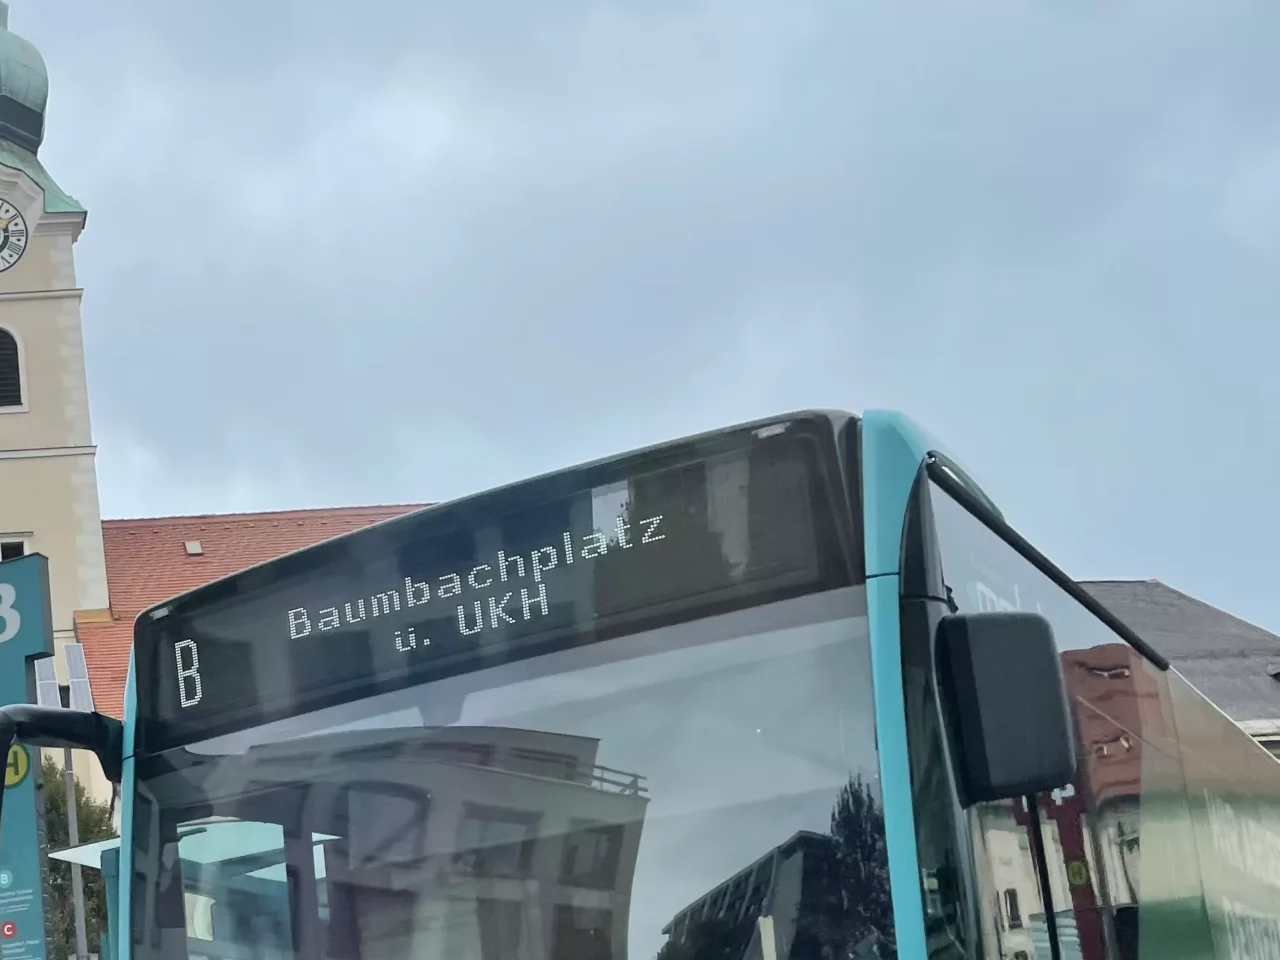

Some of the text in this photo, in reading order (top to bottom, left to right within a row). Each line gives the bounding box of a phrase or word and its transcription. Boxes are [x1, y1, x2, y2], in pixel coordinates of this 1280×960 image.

[286, 514, 668, 640] Baumbachplatz
[394, 583, 551, 653] ü. UKH
[174, 638, 204, 709] B
[0, 873, 9, 884] B
[4, 924, 13, 935] C
